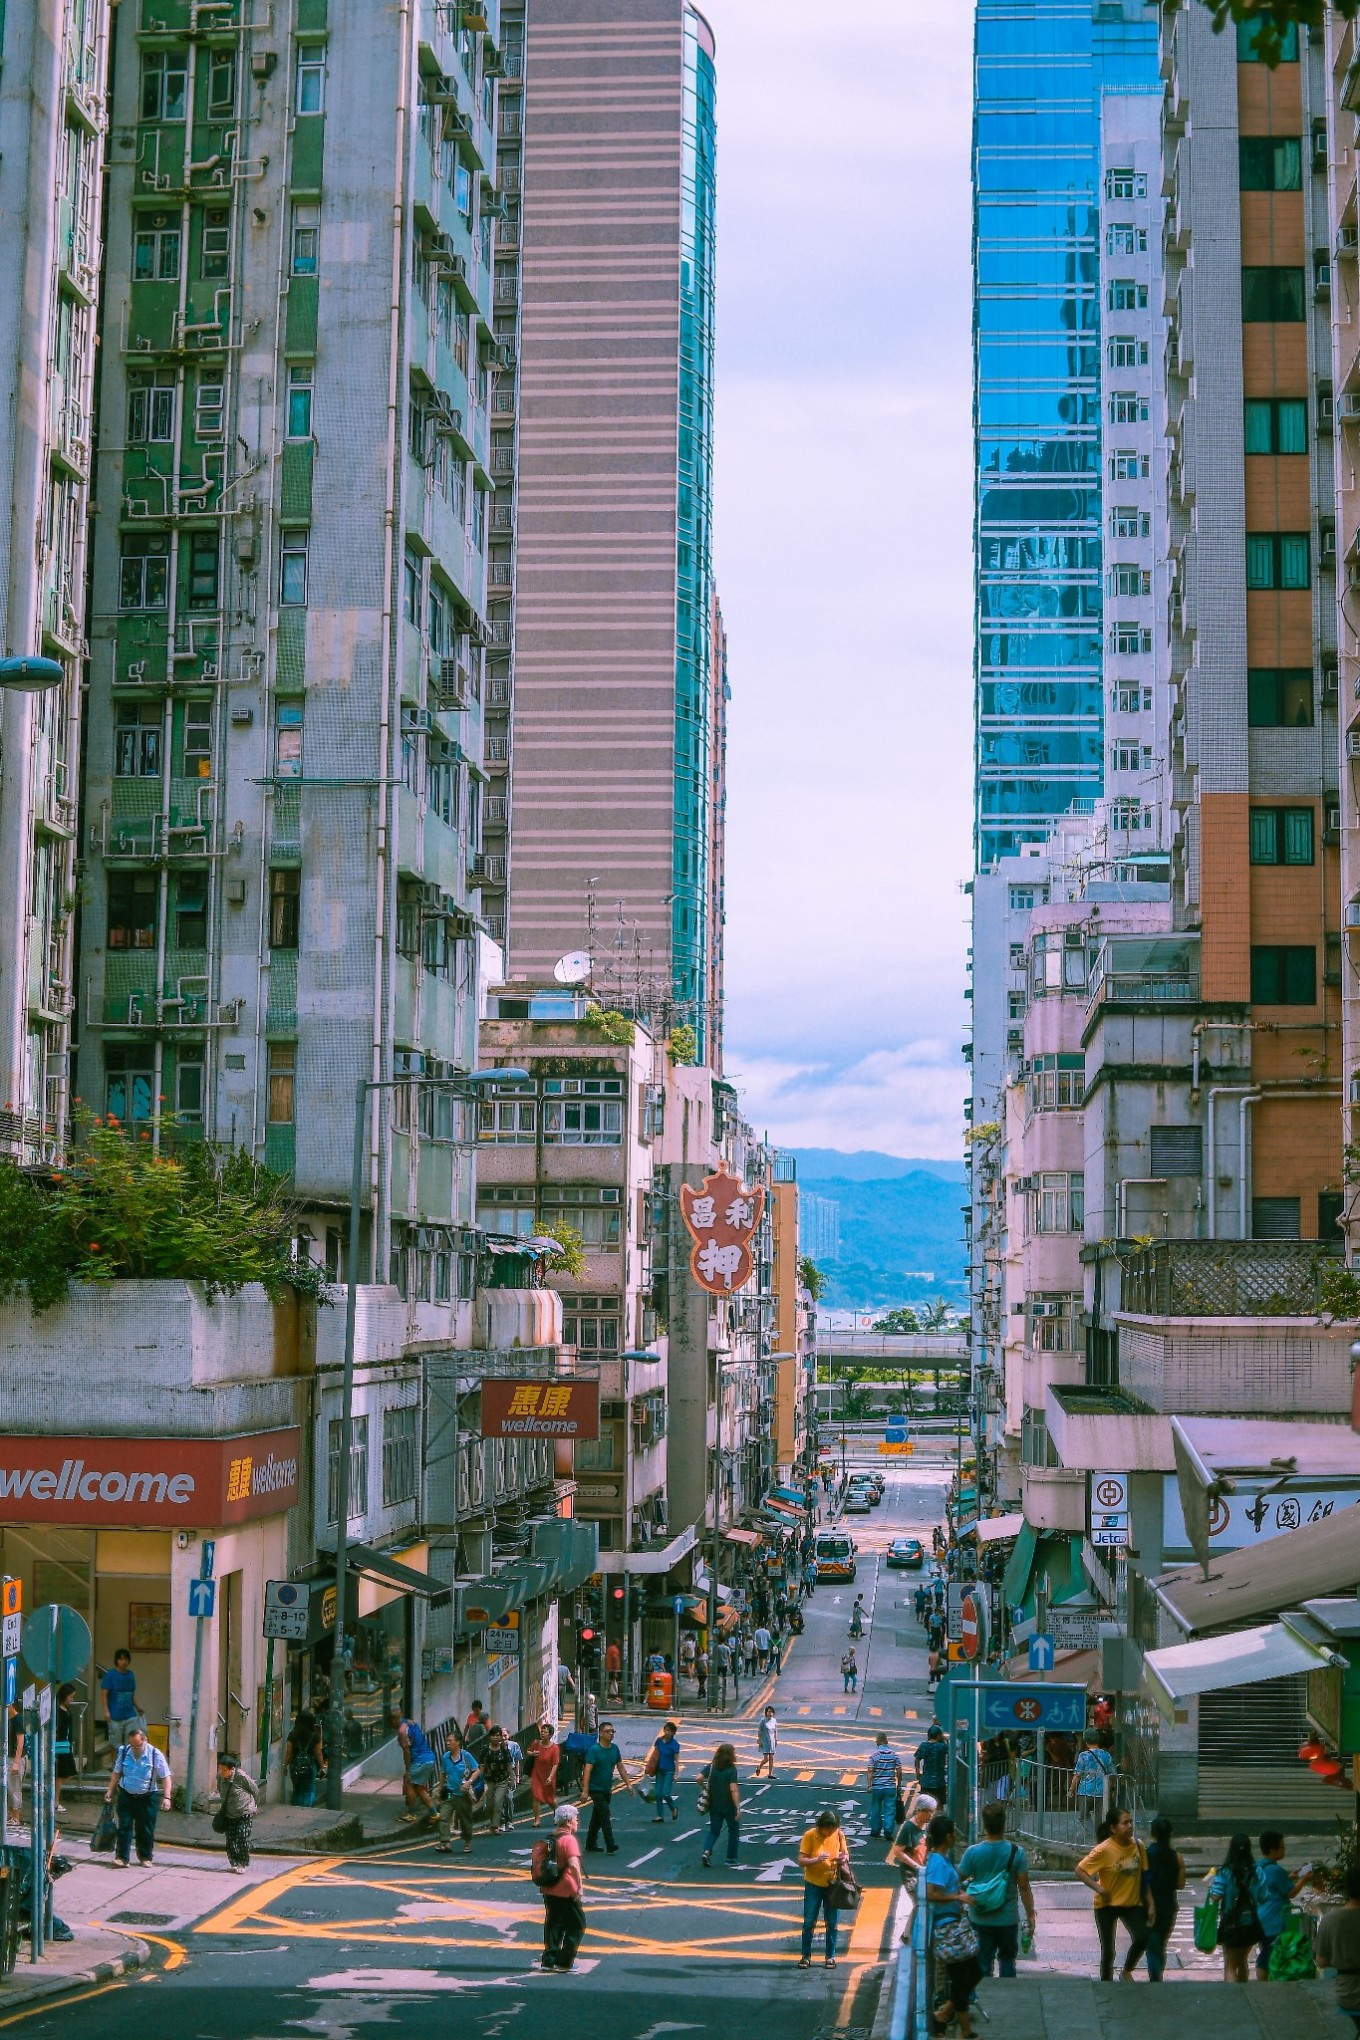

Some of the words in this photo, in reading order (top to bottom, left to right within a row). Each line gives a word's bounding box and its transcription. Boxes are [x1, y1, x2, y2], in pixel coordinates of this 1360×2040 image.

[697, 1238, 743, 1290] 押
[507, 1385, 573, 1416] 惠康
[501, 1416, 578, 1433] wellcome
[0, 1459, 195, 1503] wellcome
[226, 1456, 253, 1502] 惠康
[252, 1452, 297, 1495] wellcome
[8, 1617, 17, 1630] End
[490, 1630, 500, 1638] 24
[501, 1629, 515, 1639] hrs
[493, 1639, 512, 1649] 全日
